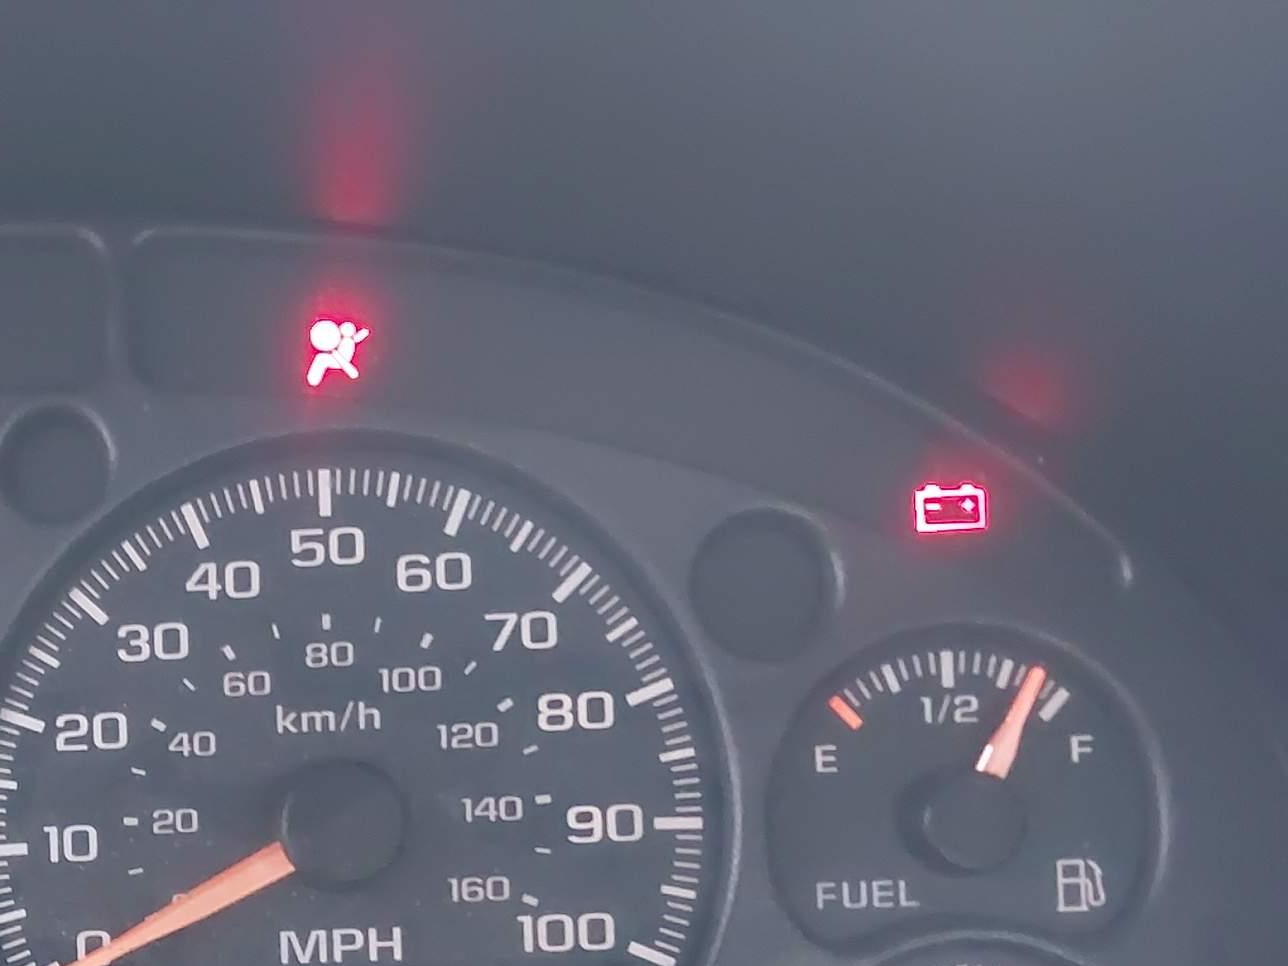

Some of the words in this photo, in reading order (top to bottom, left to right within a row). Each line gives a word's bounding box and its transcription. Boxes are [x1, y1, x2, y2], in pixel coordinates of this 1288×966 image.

[290, 527, 366, 567] 50
[186, 561, 261, 599] 40
[396, 553, 472, 592] 60
[117, 622, 189, 662] 30
[484, 612, 559, 651] 70
[304, 642, 354, 668] 80
[223, 671, 271, 697] 60
[378, 667, 442, 692] 100
[274, 701, 382, 734] km/h
[536, 690, 615, 731] 80
[920, 695, 979, 723] 1/2
[54, 712, 128, 752] 20
[168, 732, 216, 757] 40
[437, 722, 499, 749] 120
[814, 744, 838, 773] E
[1070, 734, 1094, 763] F
[152, 808, 198, 835] 20
[461, 796, 524, 823] 140
[566, 804, 644, 844] 90
[43, 824, 98, 864] 10
[448, 876, 511, 902] 160
[815, 879, 920, 910] FUEL
[279, 926, 404, 965] MPH
[517, 912, 615, 953] 100
